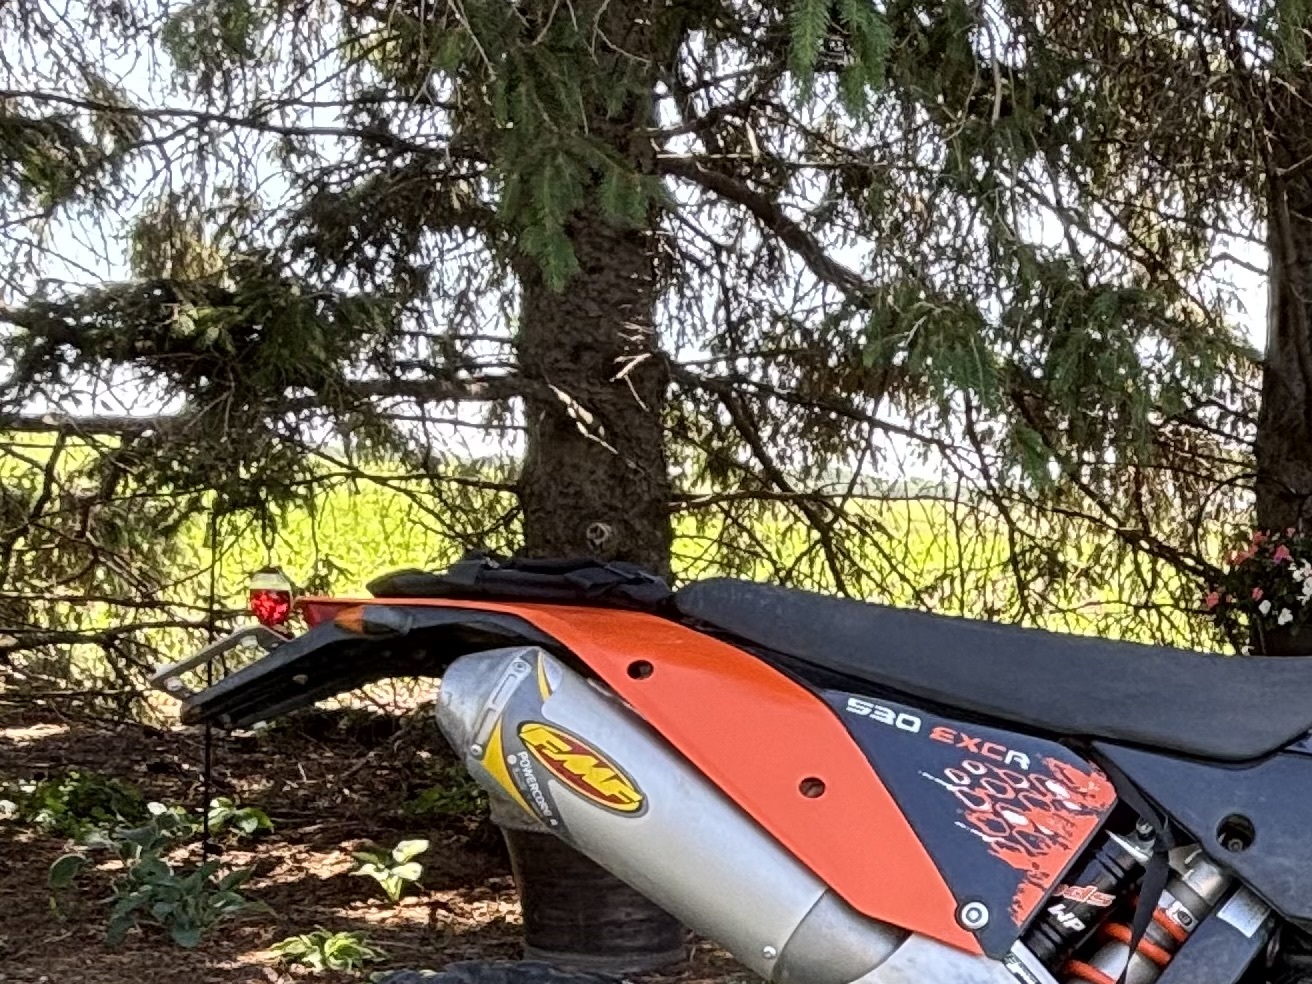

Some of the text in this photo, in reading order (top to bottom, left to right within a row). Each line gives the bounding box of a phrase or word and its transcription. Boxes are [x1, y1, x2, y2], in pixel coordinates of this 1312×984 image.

[846, 697, 922, 733] 530
[519, 727, 643, 804] FMF
[1047, 903, 1086, 931] WP
